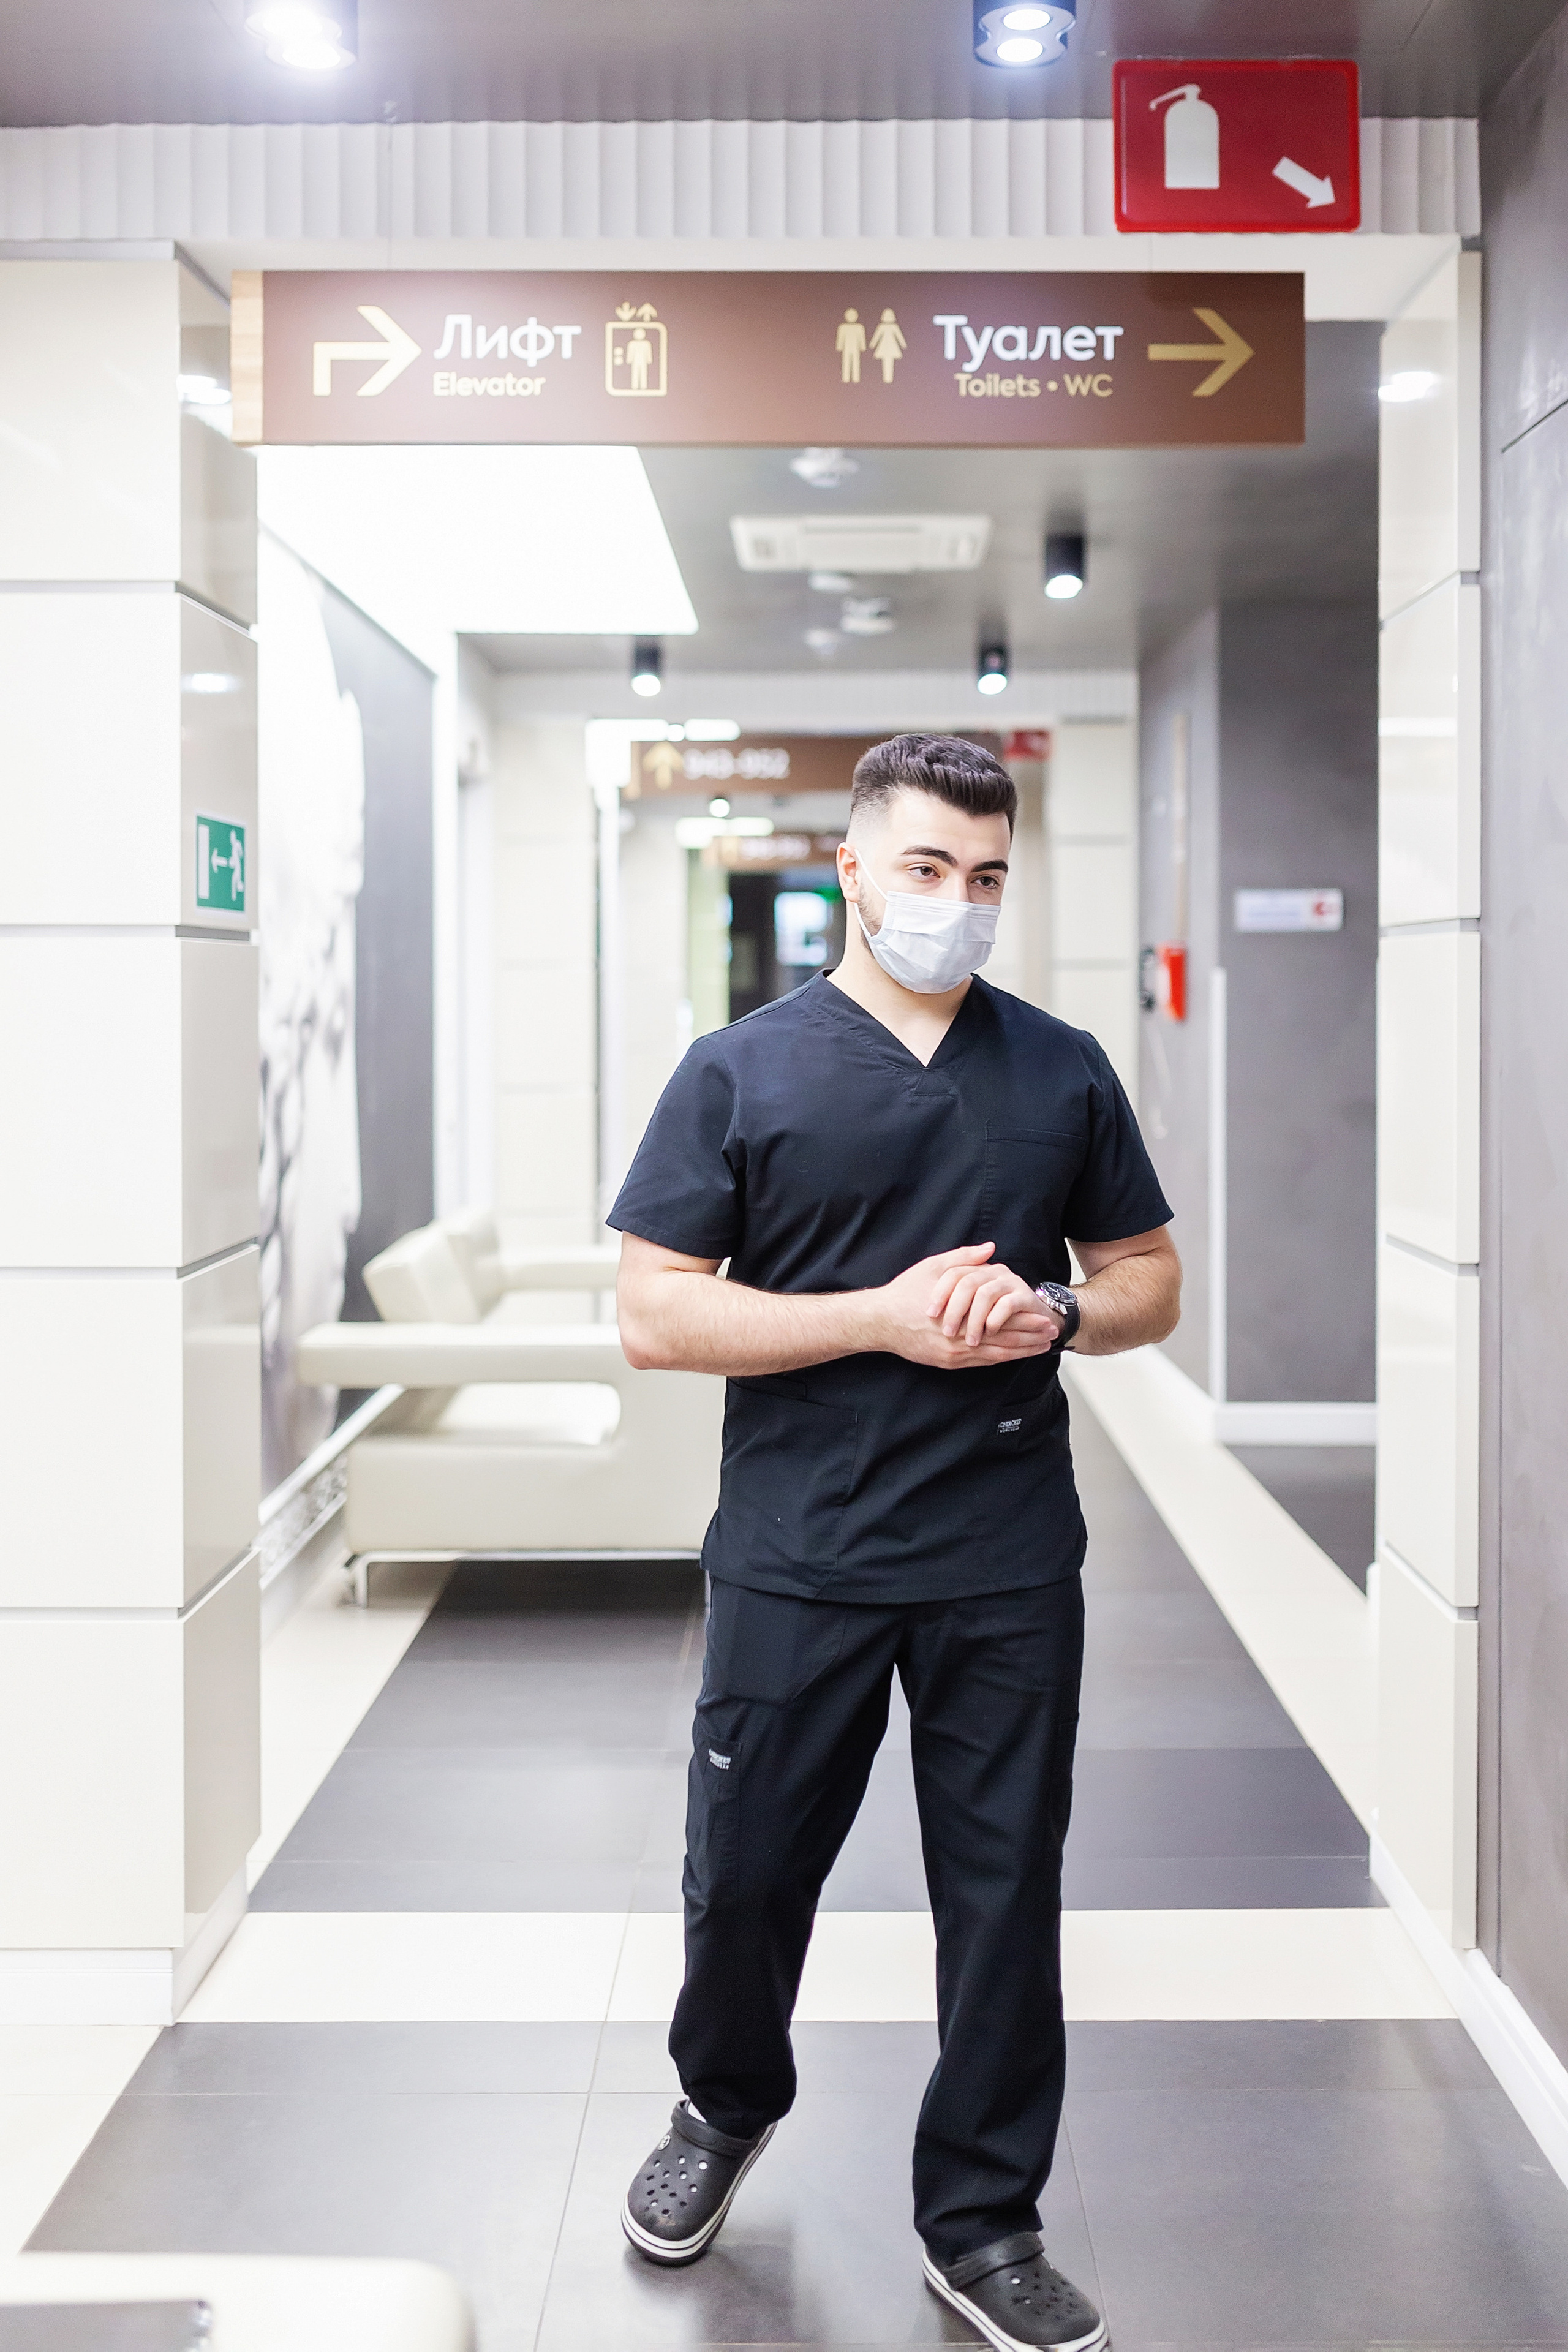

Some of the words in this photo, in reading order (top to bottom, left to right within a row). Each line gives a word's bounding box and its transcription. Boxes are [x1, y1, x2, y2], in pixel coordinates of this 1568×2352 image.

[433, 314, 582, 368] Лифт
[933, 315, 1125, 373] Туалет
[433, 372, 546, 396] Elevator
[954, 374, 1041, 397] Toilets
[1064, 374, 1113, 397] WC
